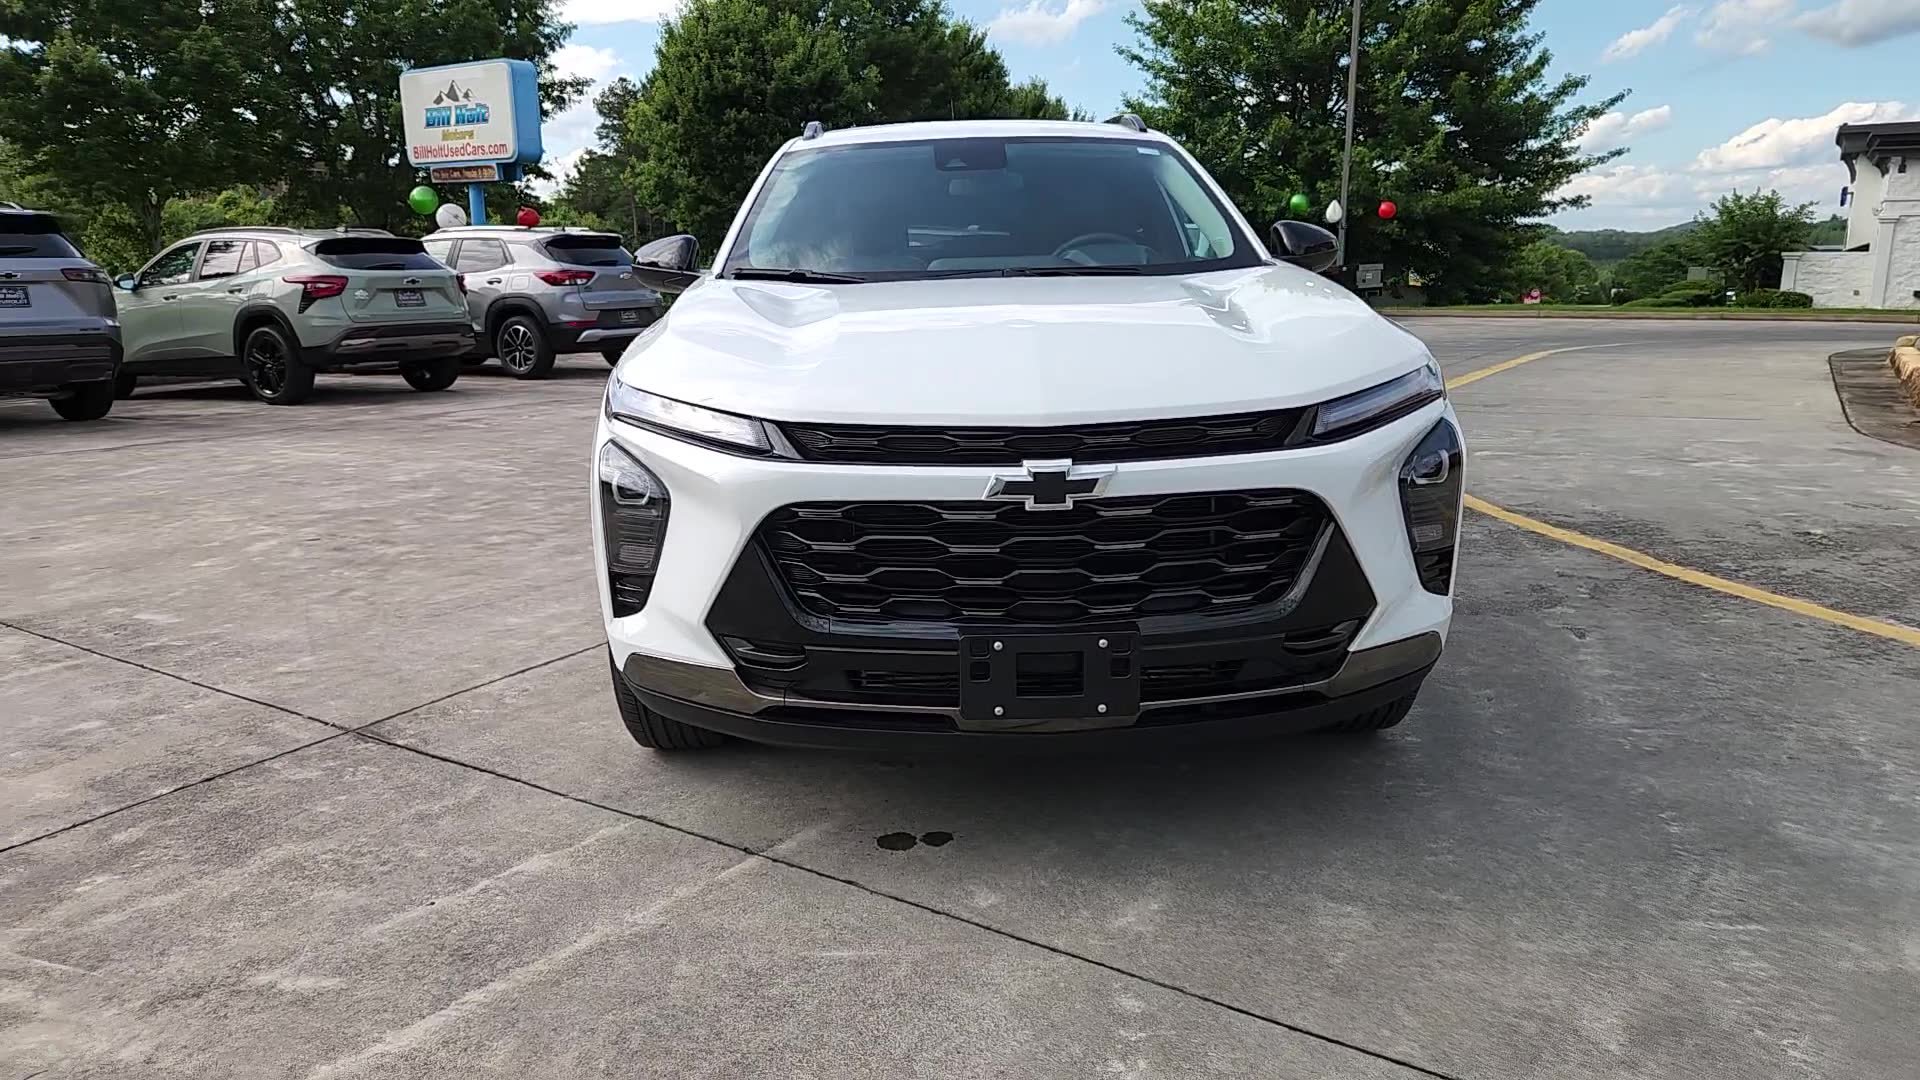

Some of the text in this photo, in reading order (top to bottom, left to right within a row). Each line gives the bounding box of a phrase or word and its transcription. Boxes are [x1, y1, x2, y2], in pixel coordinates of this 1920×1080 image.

[424, 102, 489, 129] Bill Holt
[413, 142, 508, 159] BillHoltUsedCars.com
